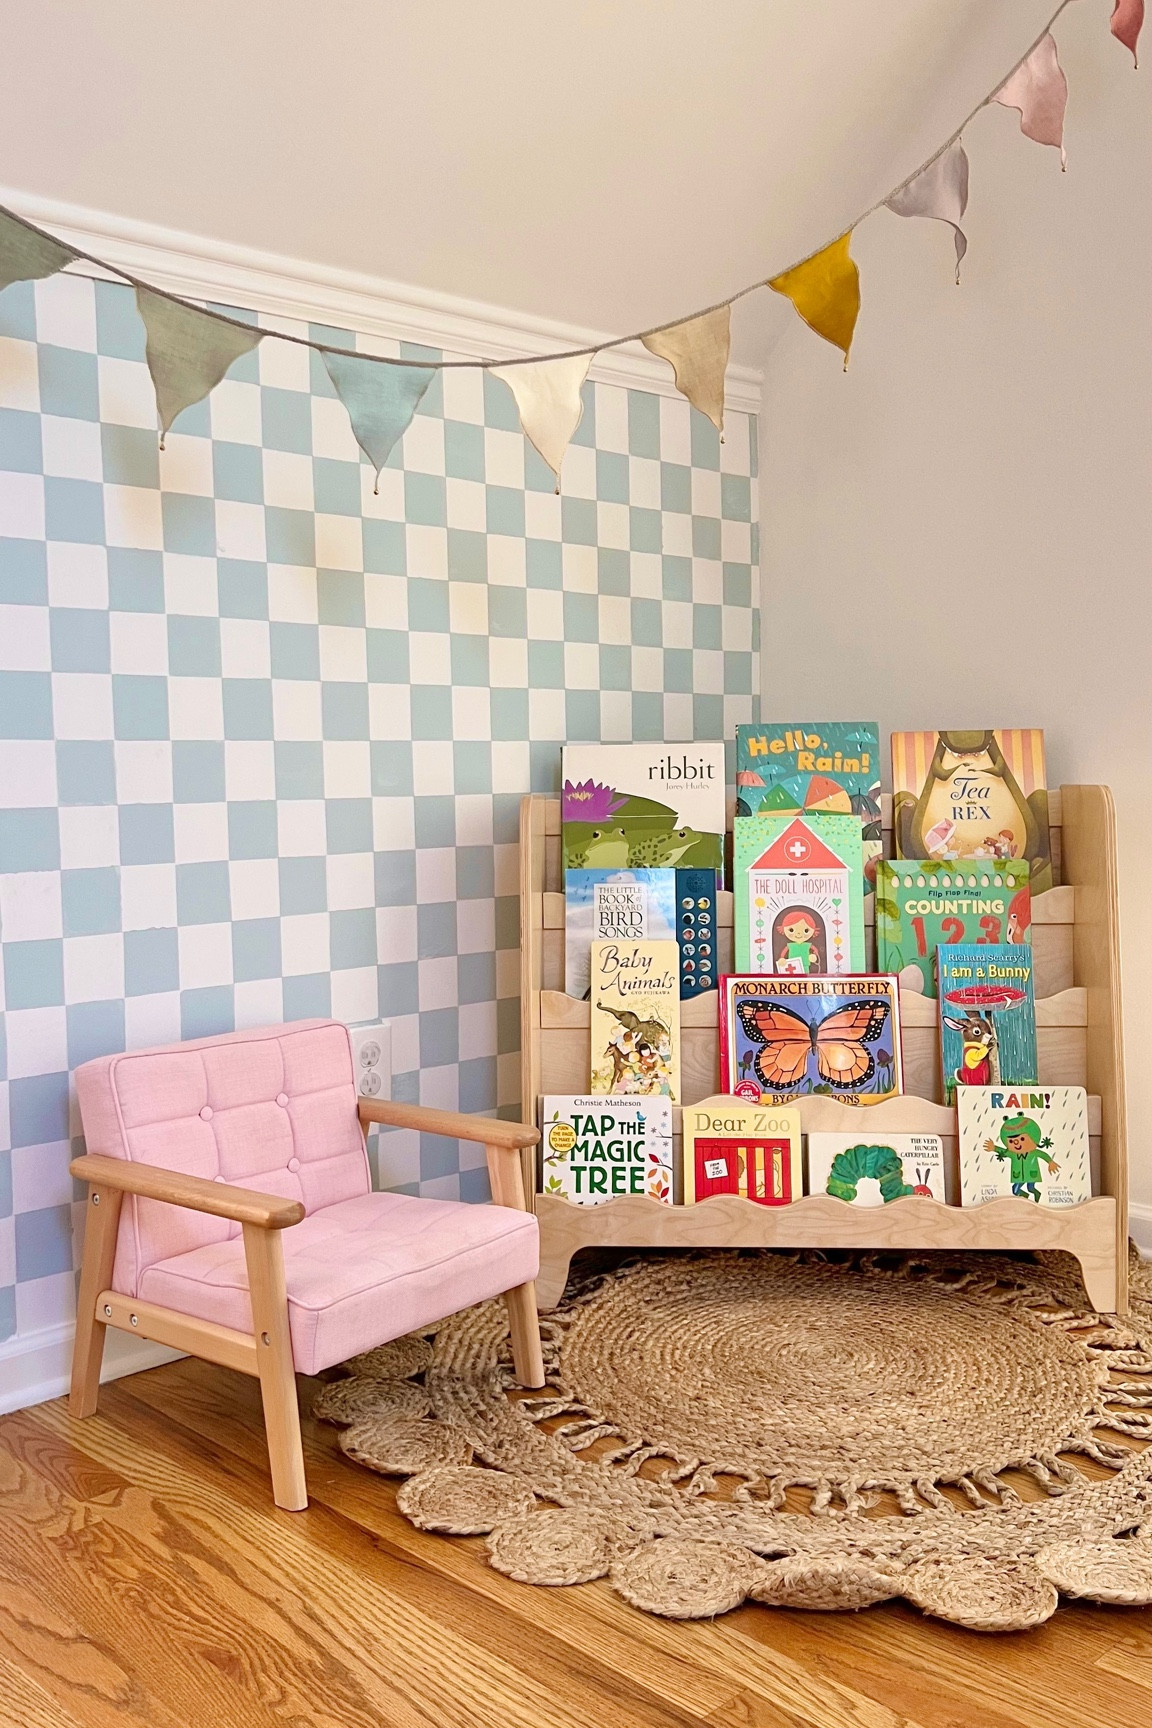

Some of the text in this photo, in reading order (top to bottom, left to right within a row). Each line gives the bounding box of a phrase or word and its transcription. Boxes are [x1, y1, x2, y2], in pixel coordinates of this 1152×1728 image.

[748, 730, 828, 757] Hello,
[648, 755, 716, 780] ribbit
[797, 751, 870, 774] Rain!
[950, 777, 991, 801] Tea
[952, 806, 992, 820] REX
[755, 878, 844, 894] THE DOLL HOSPITAL
[928, 890, 943, 898] Flip
[963, 889, 982, 897] Find!
[599, 894, 634, 904] BOOK
[904, 899, 1005, 915] COUNTING
[599, 911, 643, 926] BIRD
[599, 926, 643, 939] SONGS
[911, 914, 1002, 957] 1 2 3
[599, 945, 653, 975] Baby
[948, 954, 1025, 963] Richard Scarry's
[943, 964, 1031, 982] I am a Bunny
[600, 970, 676, 996] Animals
[733, 981, 890, 995] MONARCH BUTTERFLY
[573, 1099, 641, 1107] Christie Matheson
[991, 1092, 1050, 1109] RAIN!
[570, 1114, 646, 1137] TAP THE
[694, 1113, 790, 1132] Dear Zoo
[570, 1140, 645, 1163] MAGIC
[570, 1166, 645, 1194] TREE
